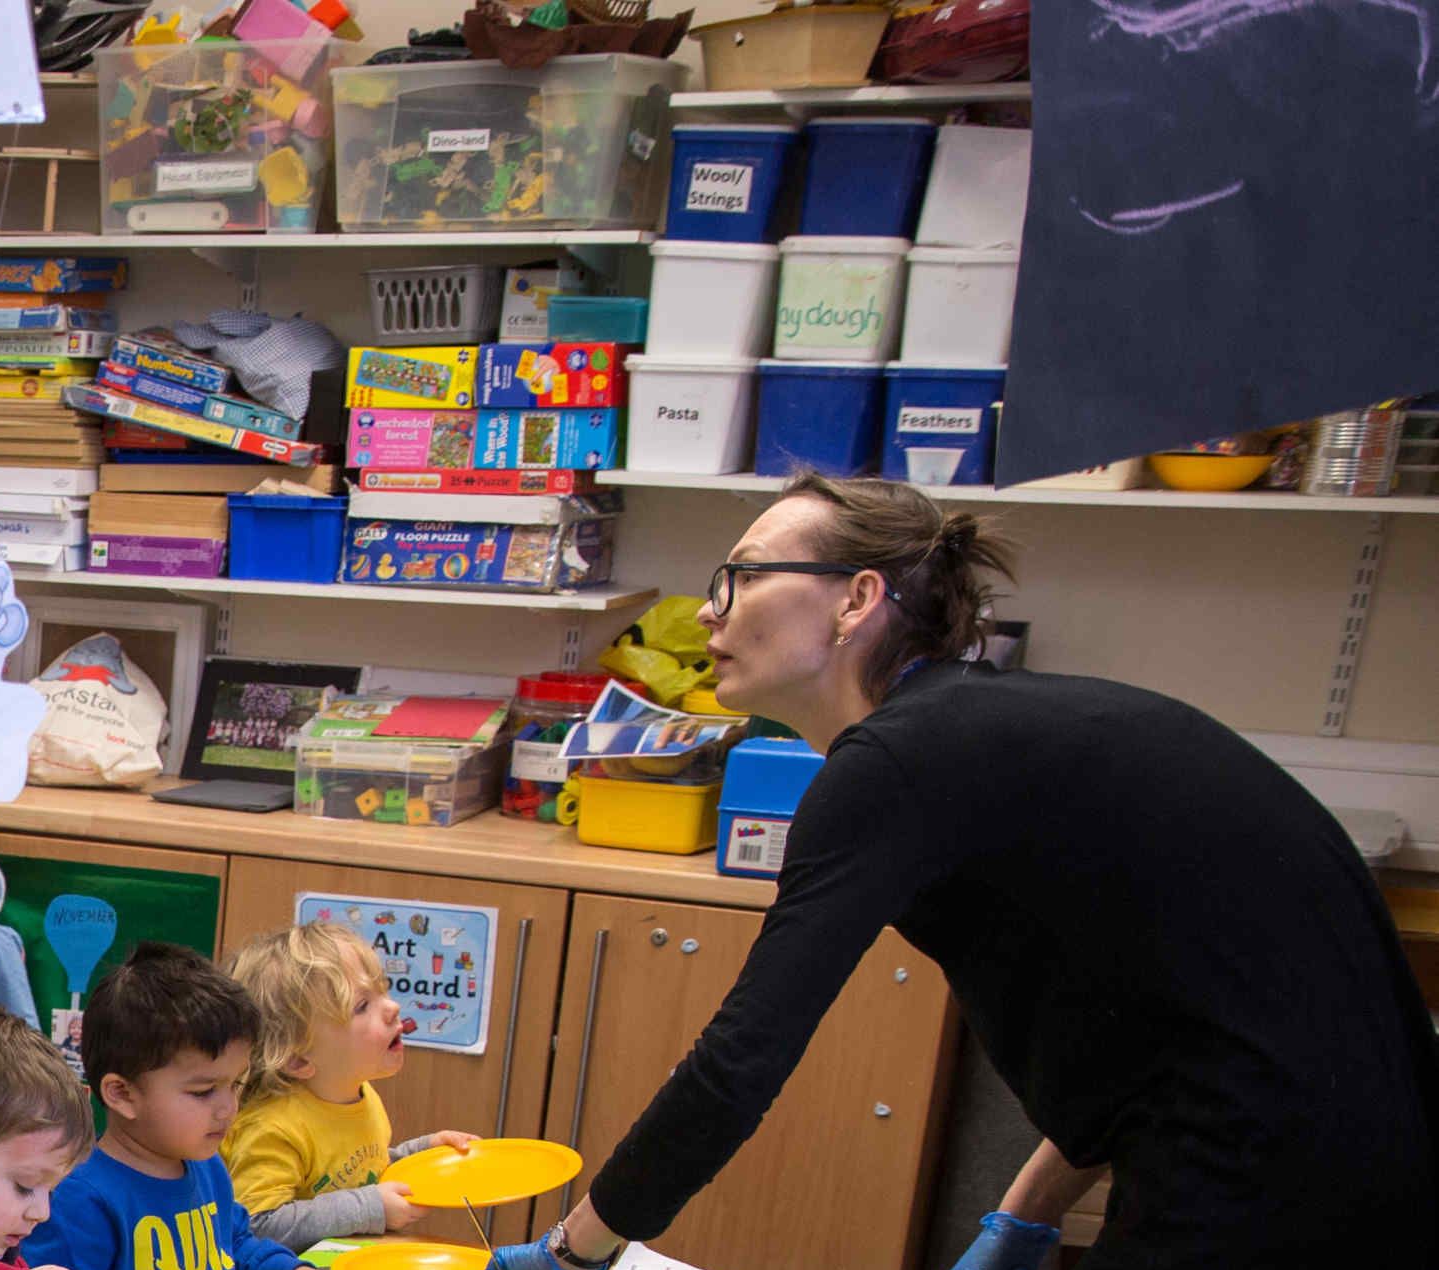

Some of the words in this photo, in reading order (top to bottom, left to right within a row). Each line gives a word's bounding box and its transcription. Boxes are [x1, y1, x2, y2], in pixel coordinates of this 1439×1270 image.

[432, 134, 486, 148] Dino-land
[694, 167, 745, 184] Wool/
[688, 190, 745, 209] Strings
[136, 353, 194, 380] Numbers
[657, 406, 700, 422] Pasta
[901, 412, 973, 429] Feathers
[374, 417, 431, 431] enchanted
[384, 429, 418, 441] forest
[394, 532, 430, 542] FLOOR
[430, 532, 472, 543] PUZZLE
[52, 906, 117, 928] NOVEMBER
[373, 931, 417, 958] Art
